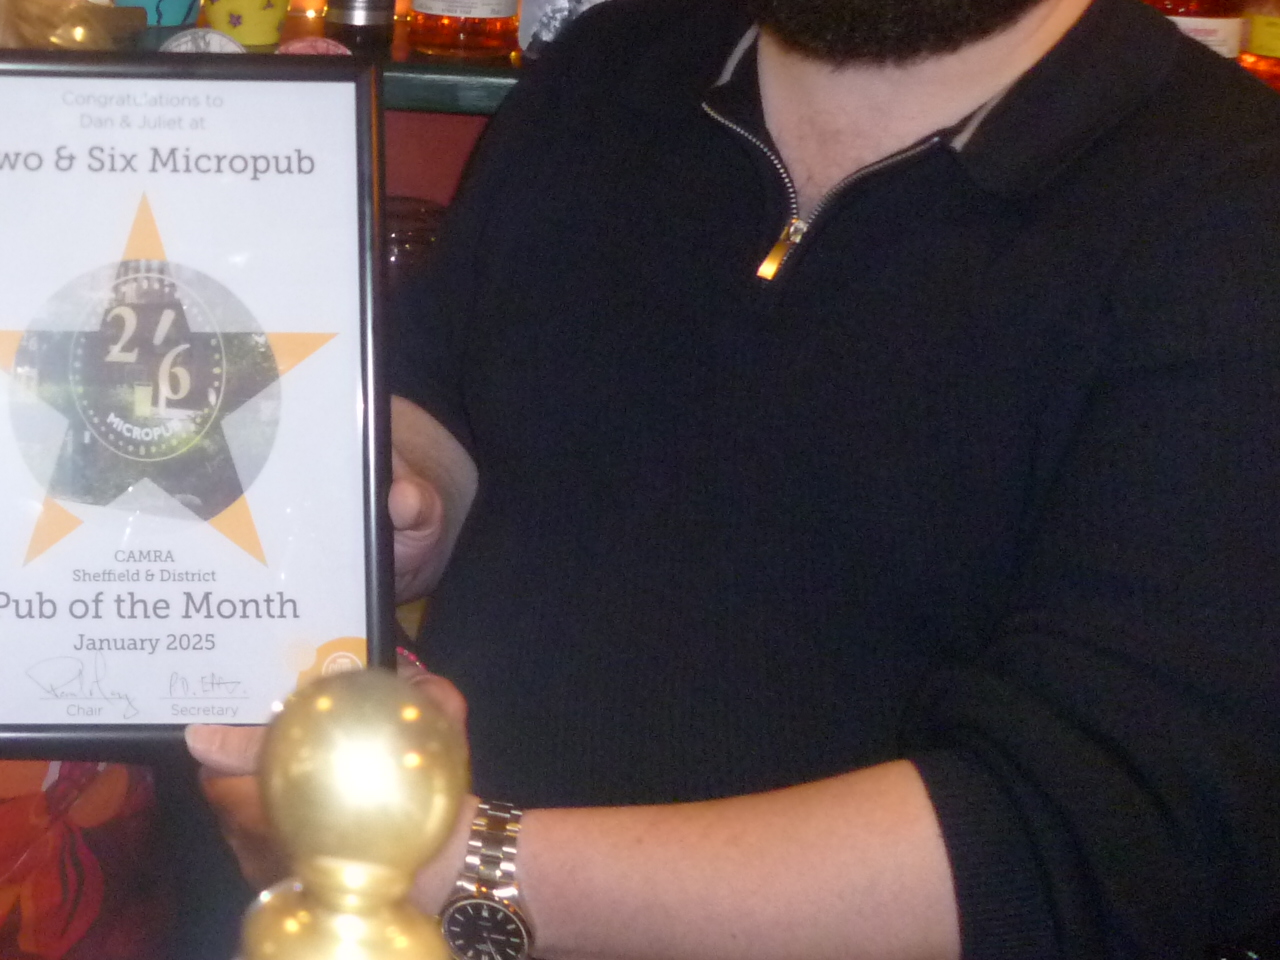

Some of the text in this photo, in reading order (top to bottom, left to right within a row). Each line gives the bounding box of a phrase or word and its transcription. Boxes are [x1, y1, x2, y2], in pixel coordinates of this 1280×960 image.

[206, 92, 224, 108] to
[80, 114, 206, 131] Dan & Juliet at
[55, 146, 76, 172] &
[87, 146, 138, 173] Six
[150, 147, 316, 180] Micropub
[114, 550, 175, 563] CAMRA
[72, 569, 217, 583] Sheffield & District
[68, 591, 104, 620] of
[115, 592, 170, 620] the
[182, 592, 300, 620] Month
[73, 634, 216, 655] January 2025
[66, 704, 239, 719] Chair Secretary
